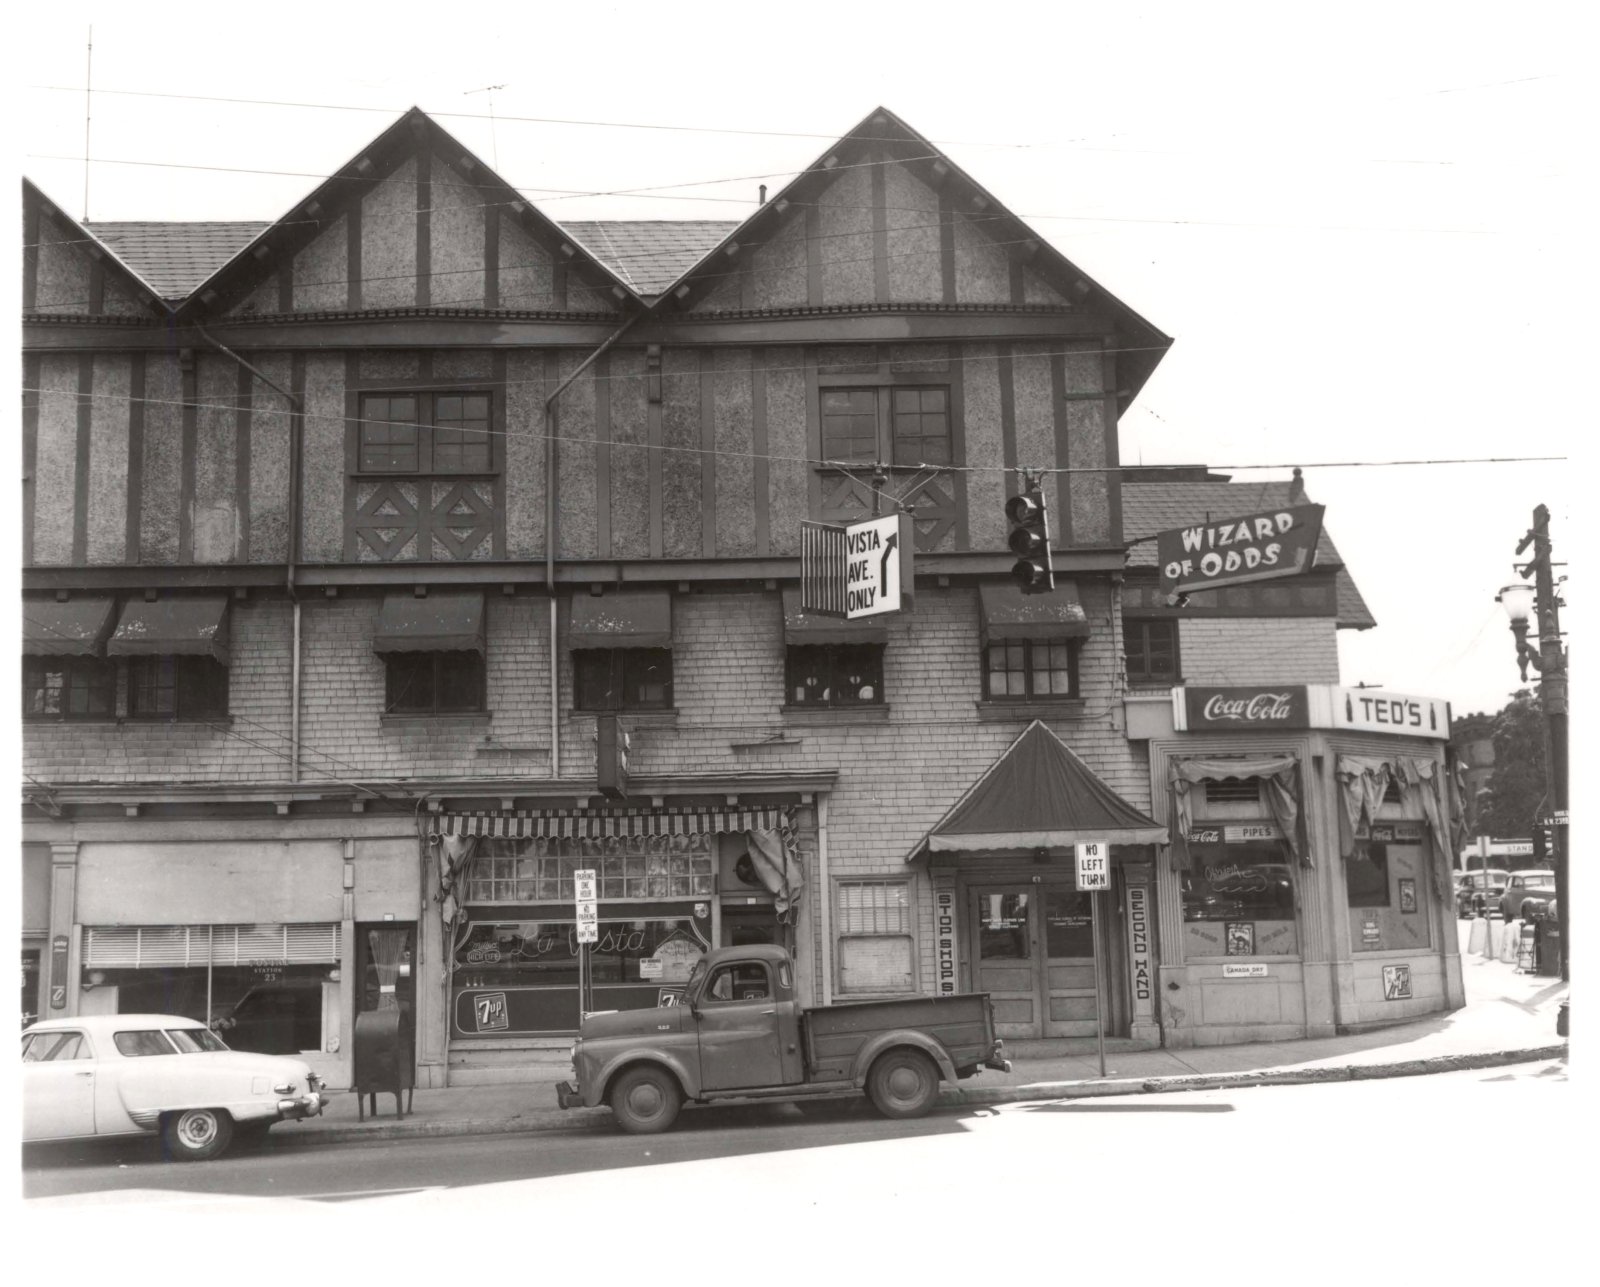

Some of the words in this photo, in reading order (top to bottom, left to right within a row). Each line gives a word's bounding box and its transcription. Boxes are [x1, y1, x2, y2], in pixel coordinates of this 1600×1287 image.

[847, 527, 880, 554] VISTA
[1182, 512, 1293, 553] WIZARD
[848, 560, 874, 583] AVE.
[1165, 558, 1195, 579] OF
[1200, 542, 1281, 576] ODDS
[848, 585, 877, 614] ONLY
[1204, 692, 1293, 720] Coca-Cola
[1360, 697, 1421, 726] TED'S
[1243, 828, 1271, 837] PIPES
[1085, 844, 1098, 855] NO
[1081, 859, 1103, 871] LEFT
[1081, 874, 1105, 886] TURN
[938, 894, 952, 936] STOP
[1130, 890, 1147, 953] SECOND
[511, 925, 554, 958] La
[939, 938, 954, 992] SHOPS
[1135, 959, 1149, 999] HAND
